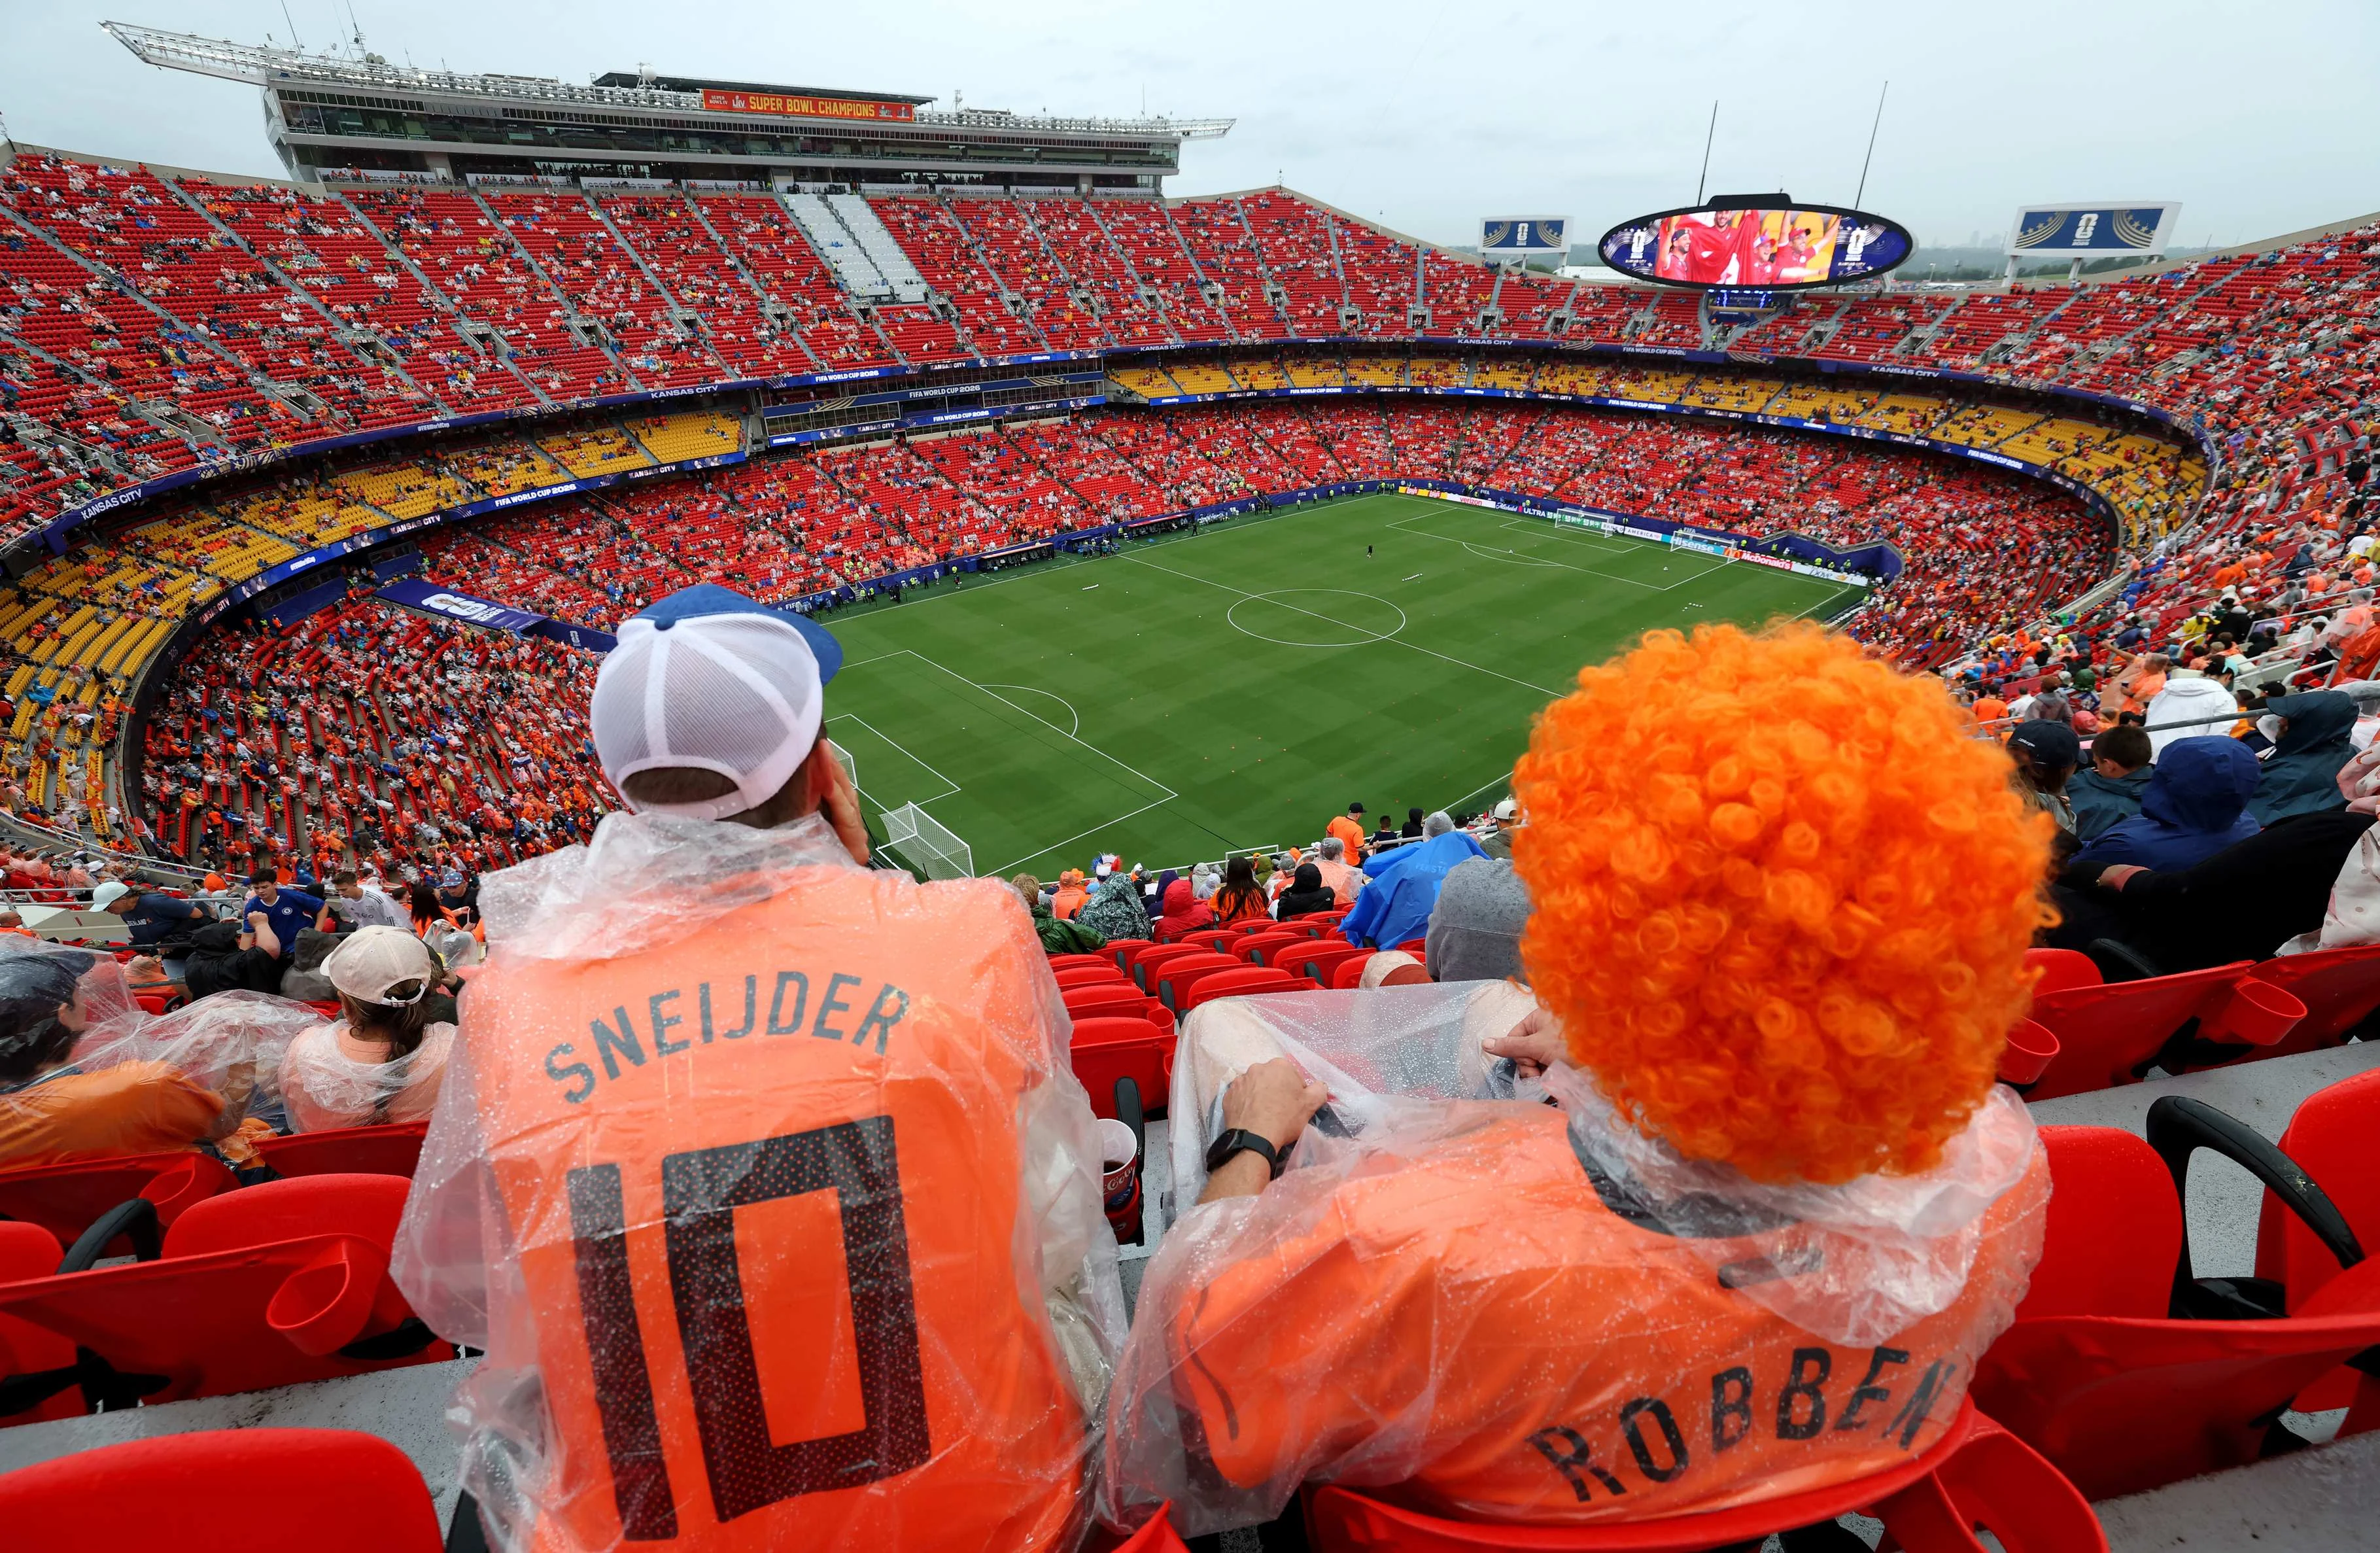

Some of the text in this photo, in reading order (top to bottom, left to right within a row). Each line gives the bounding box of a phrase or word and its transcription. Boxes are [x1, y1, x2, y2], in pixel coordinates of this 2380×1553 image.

[750, 96, 784, 111] SUPER
[787, 99, 816, 114] BOWL
[818, 101, 876, 117] CHAMPIONS
[1871, 366, 1915, 375] KANSAS
[651, 388, 694, 398] KANSAS
[923, 389, 946, 397] WORLD
[417, 422, 450, 432] #FIFAWorldCup
[629, 465, 676, 478] KANSAS CITY
[494, 483, 577, 507] FIFA WORLD CUP 2026
[1460, 497, 1482, 506] verizon
[80, 489, 142, 520] KANSAS CITY
[1523, 507, 1546, 517] ULTRA
[390, 514, 441, 534] KANSAS CITY
[1627, 529, 1654, 538] AMERICA
[1670, 536, 1715, 553] Hisense
[1741, 553, 1791, 570] McDonald's
[217, 597, 230, 612] CITY
[477, 608, 506, 621] 2026
[544, 971, 910, 1104] SNEIJDER
[566, 1115, 931, 1541] 10
[1525, 1346, 1956, 1503] ROBBEN
